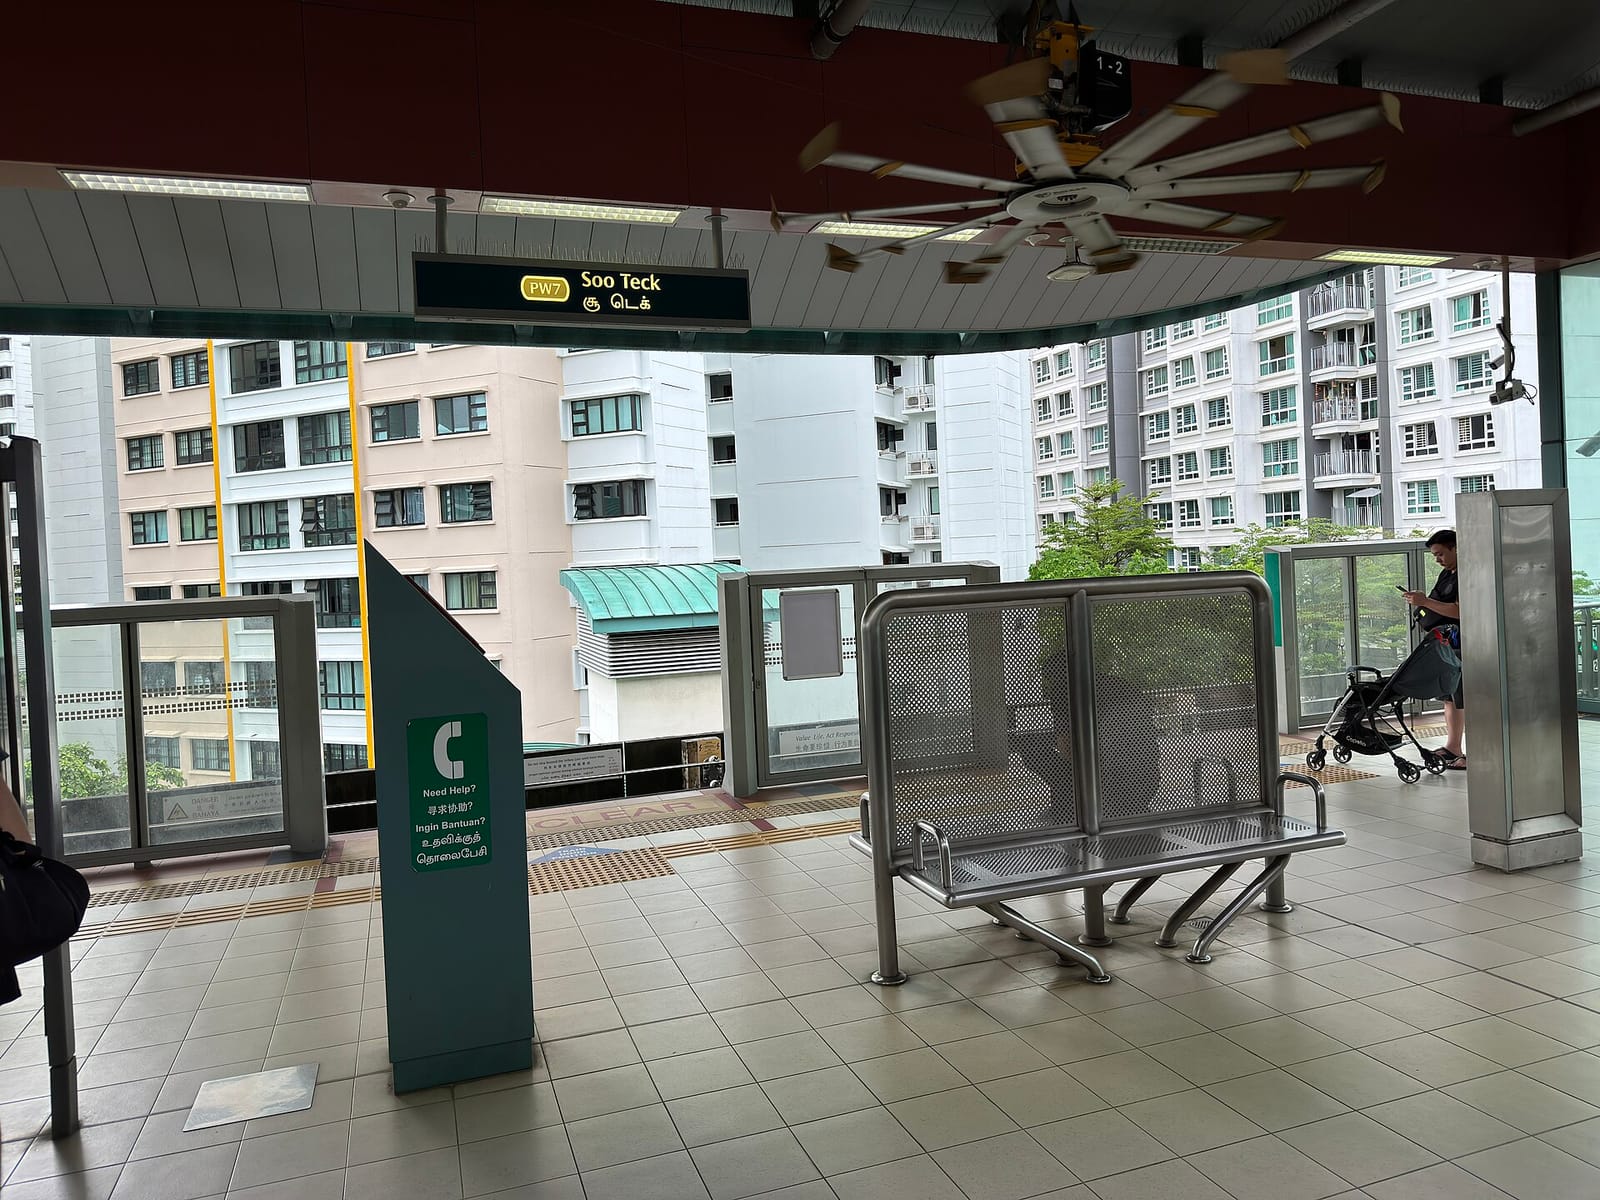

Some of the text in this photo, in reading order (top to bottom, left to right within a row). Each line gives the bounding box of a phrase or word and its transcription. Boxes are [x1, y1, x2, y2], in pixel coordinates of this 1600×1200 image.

[1096, 56, 1103, 70] 1
[1115, 61, 1123, 75] 2
[529, 282, 561, 295] PW7
[581, 271, 662, 291] Soo Teck
[583, 293, 651, 312] சூ டெக்
[423, 784, 476, 797] Need Help?
[415, 816, 486, 833] Ingin Bantuan?
[534, 802, 696, 829] CLEAR
[422, 831, 481, 849] உதவிக்குத்
[416, 845, 488, 866] தொலைபேசி
